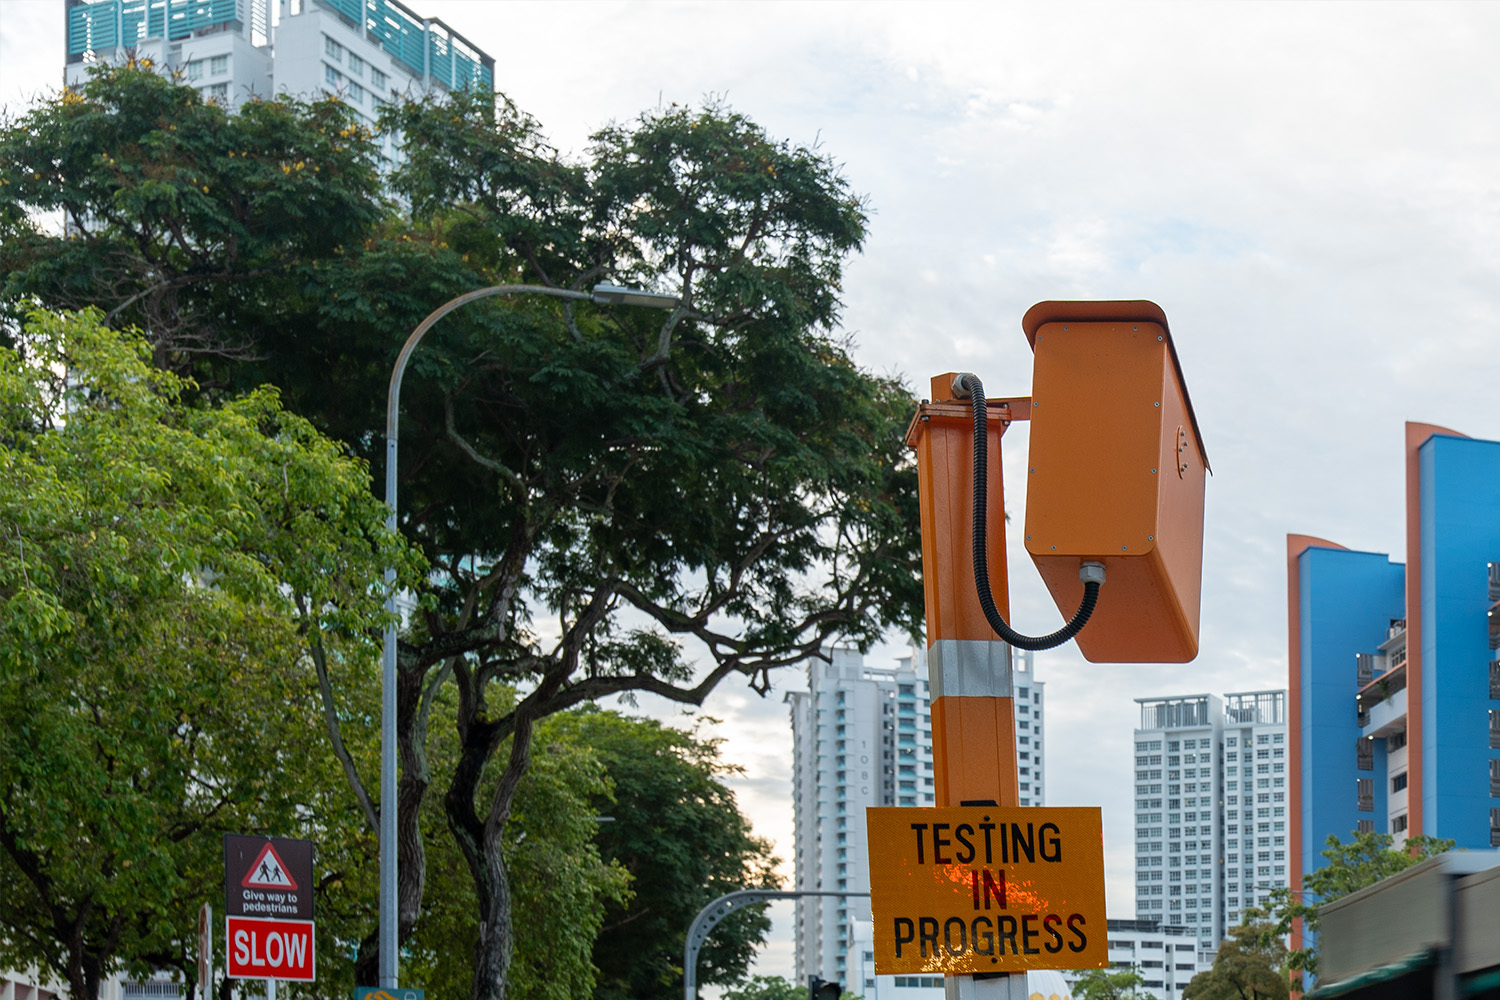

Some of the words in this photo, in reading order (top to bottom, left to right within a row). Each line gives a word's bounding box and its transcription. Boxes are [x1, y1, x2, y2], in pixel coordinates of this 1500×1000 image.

[911, 822, 1062, 865] TESTING
[242, 902, 298, 914] pedestrians
[243, 889, 265, 901] Give
[266, 893, 286, 904] way
[287, 893, 298, 903] to
[971, 869, 1007, 910] IN
[234, 929, 307, 968] SLOW
[893, 913, 1087, 959] PROGRESS
